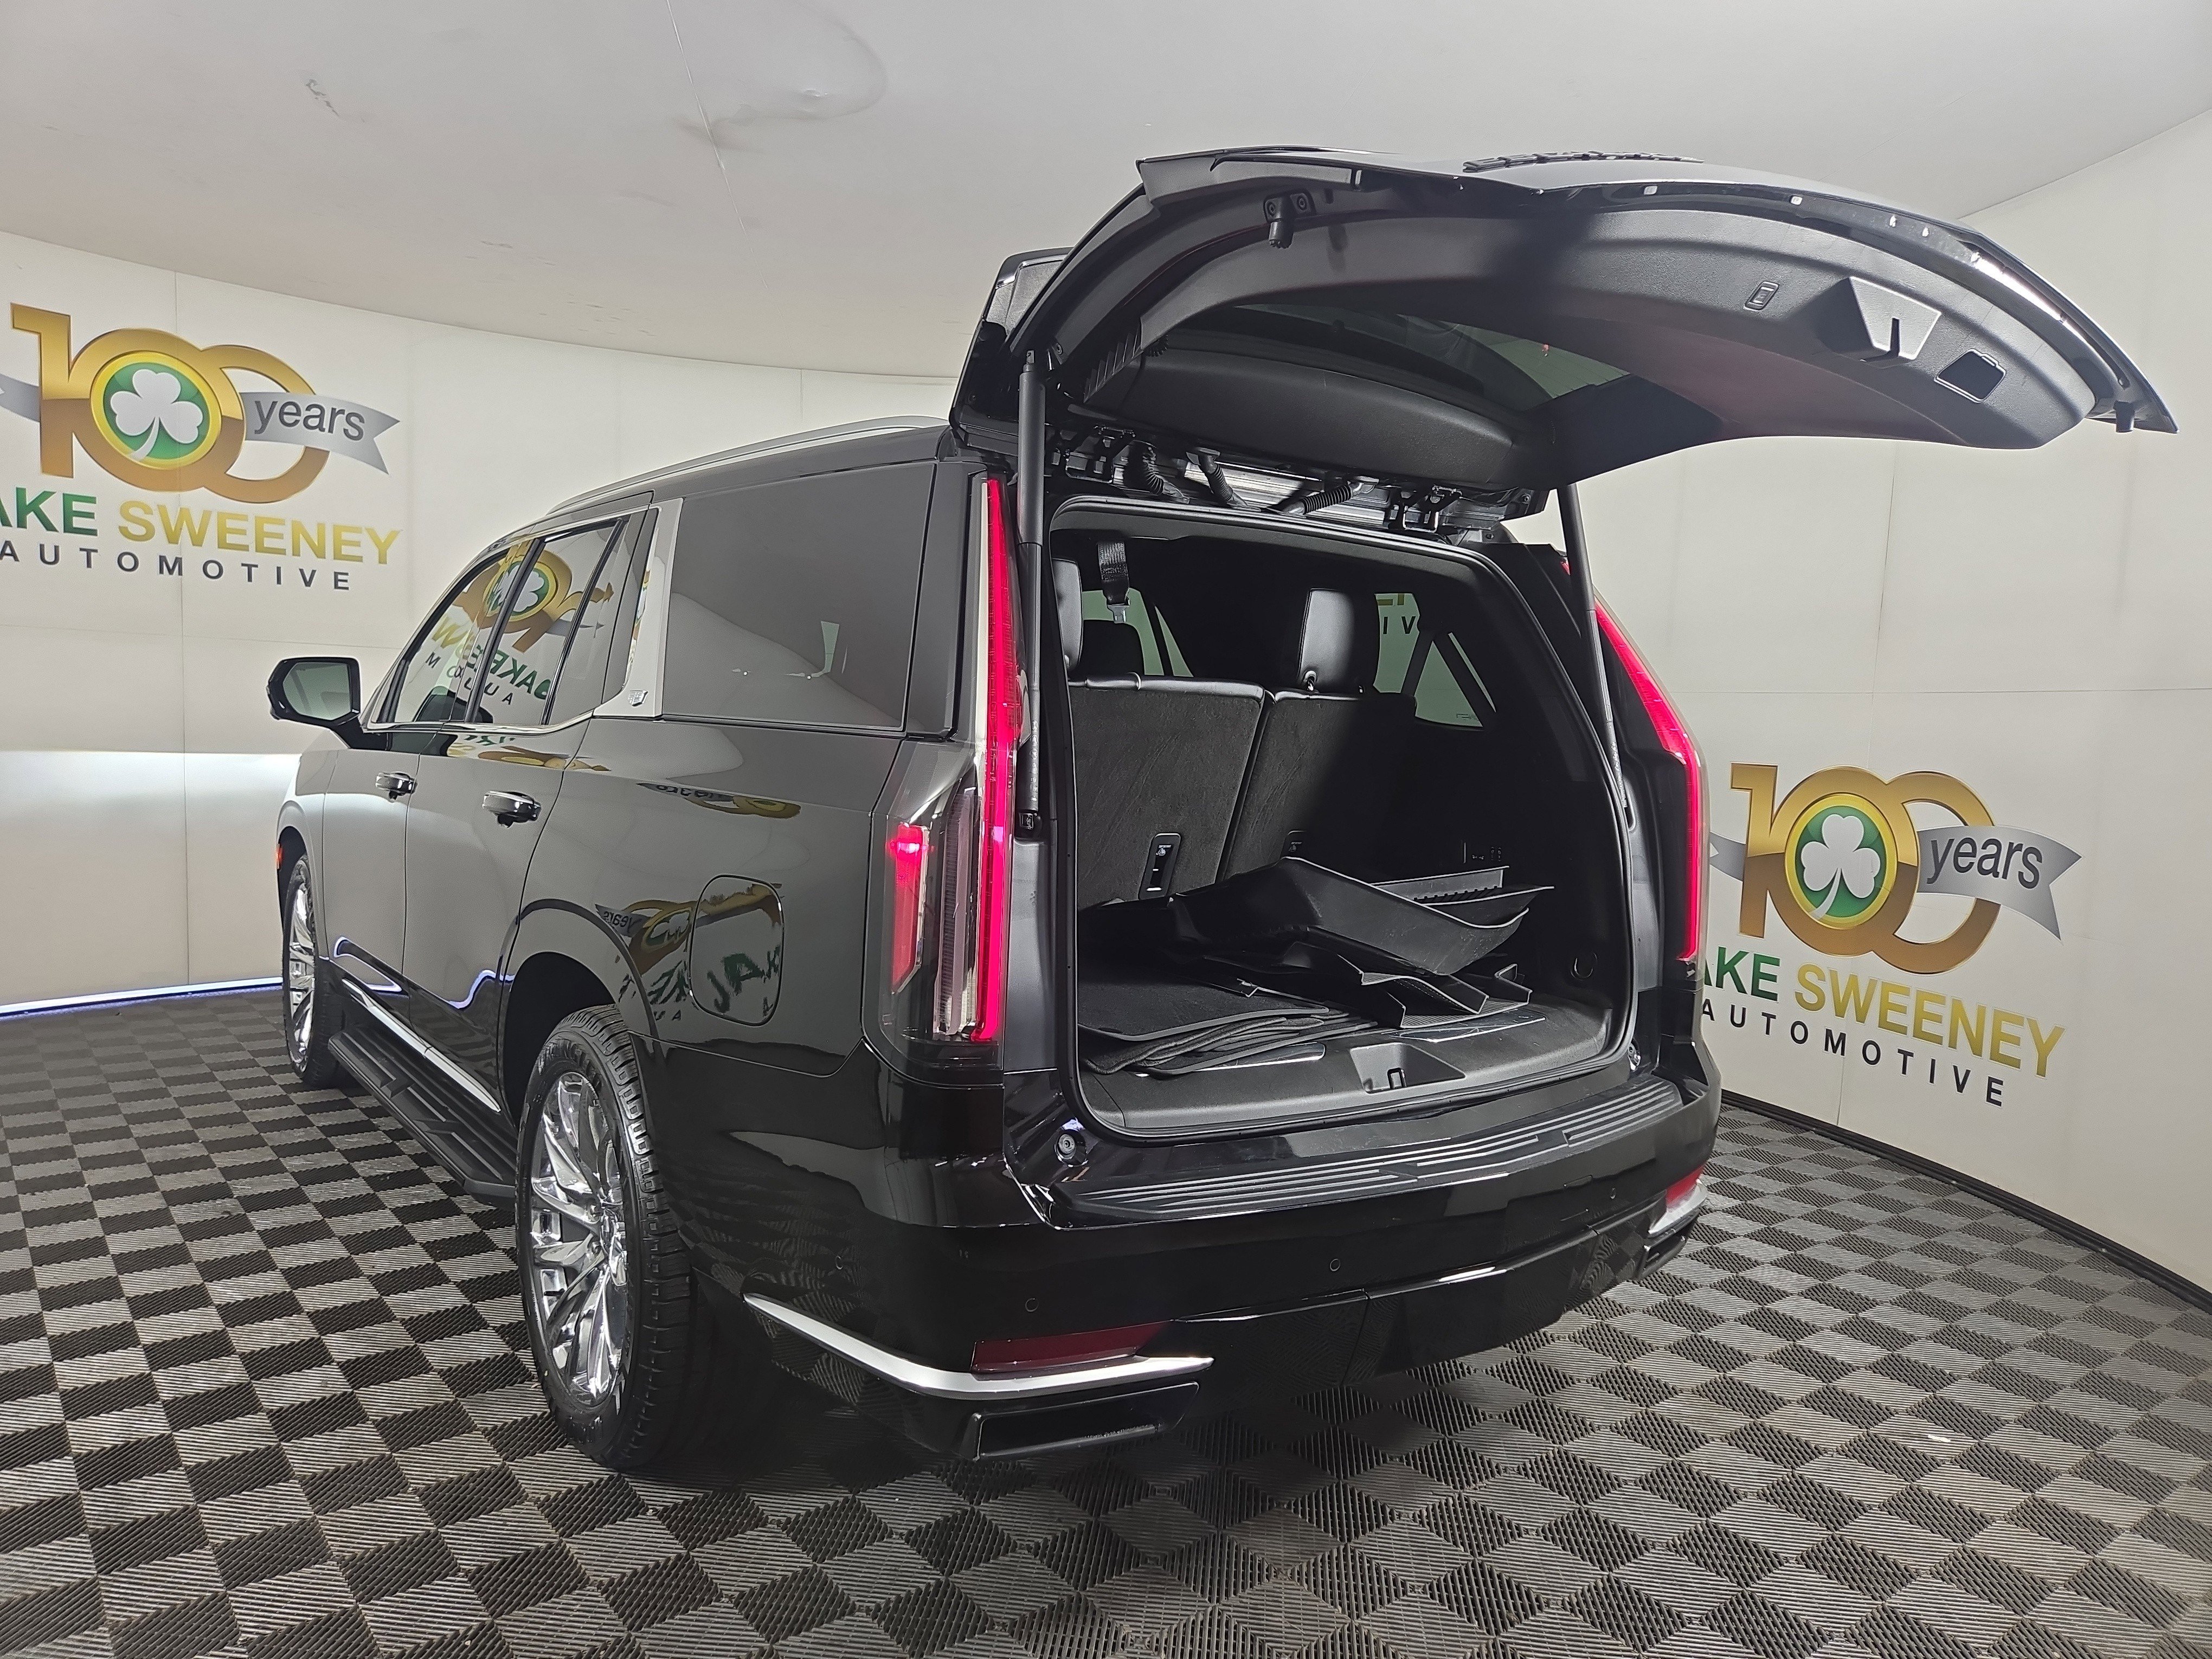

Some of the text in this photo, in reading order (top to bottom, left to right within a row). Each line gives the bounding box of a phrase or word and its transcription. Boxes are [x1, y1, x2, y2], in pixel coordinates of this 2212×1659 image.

[254, 399, 366, 441] years
[118, 500, 402, 565] SWEENEY
[0, 540, 350, 590] AUTOMOTIVE
[1926, 836, 2043, 889] years
[1704, 946, 2066, 1078] KE SWEENEY
[1702, 998, 2004, 1107] AUTOMOTIVE
